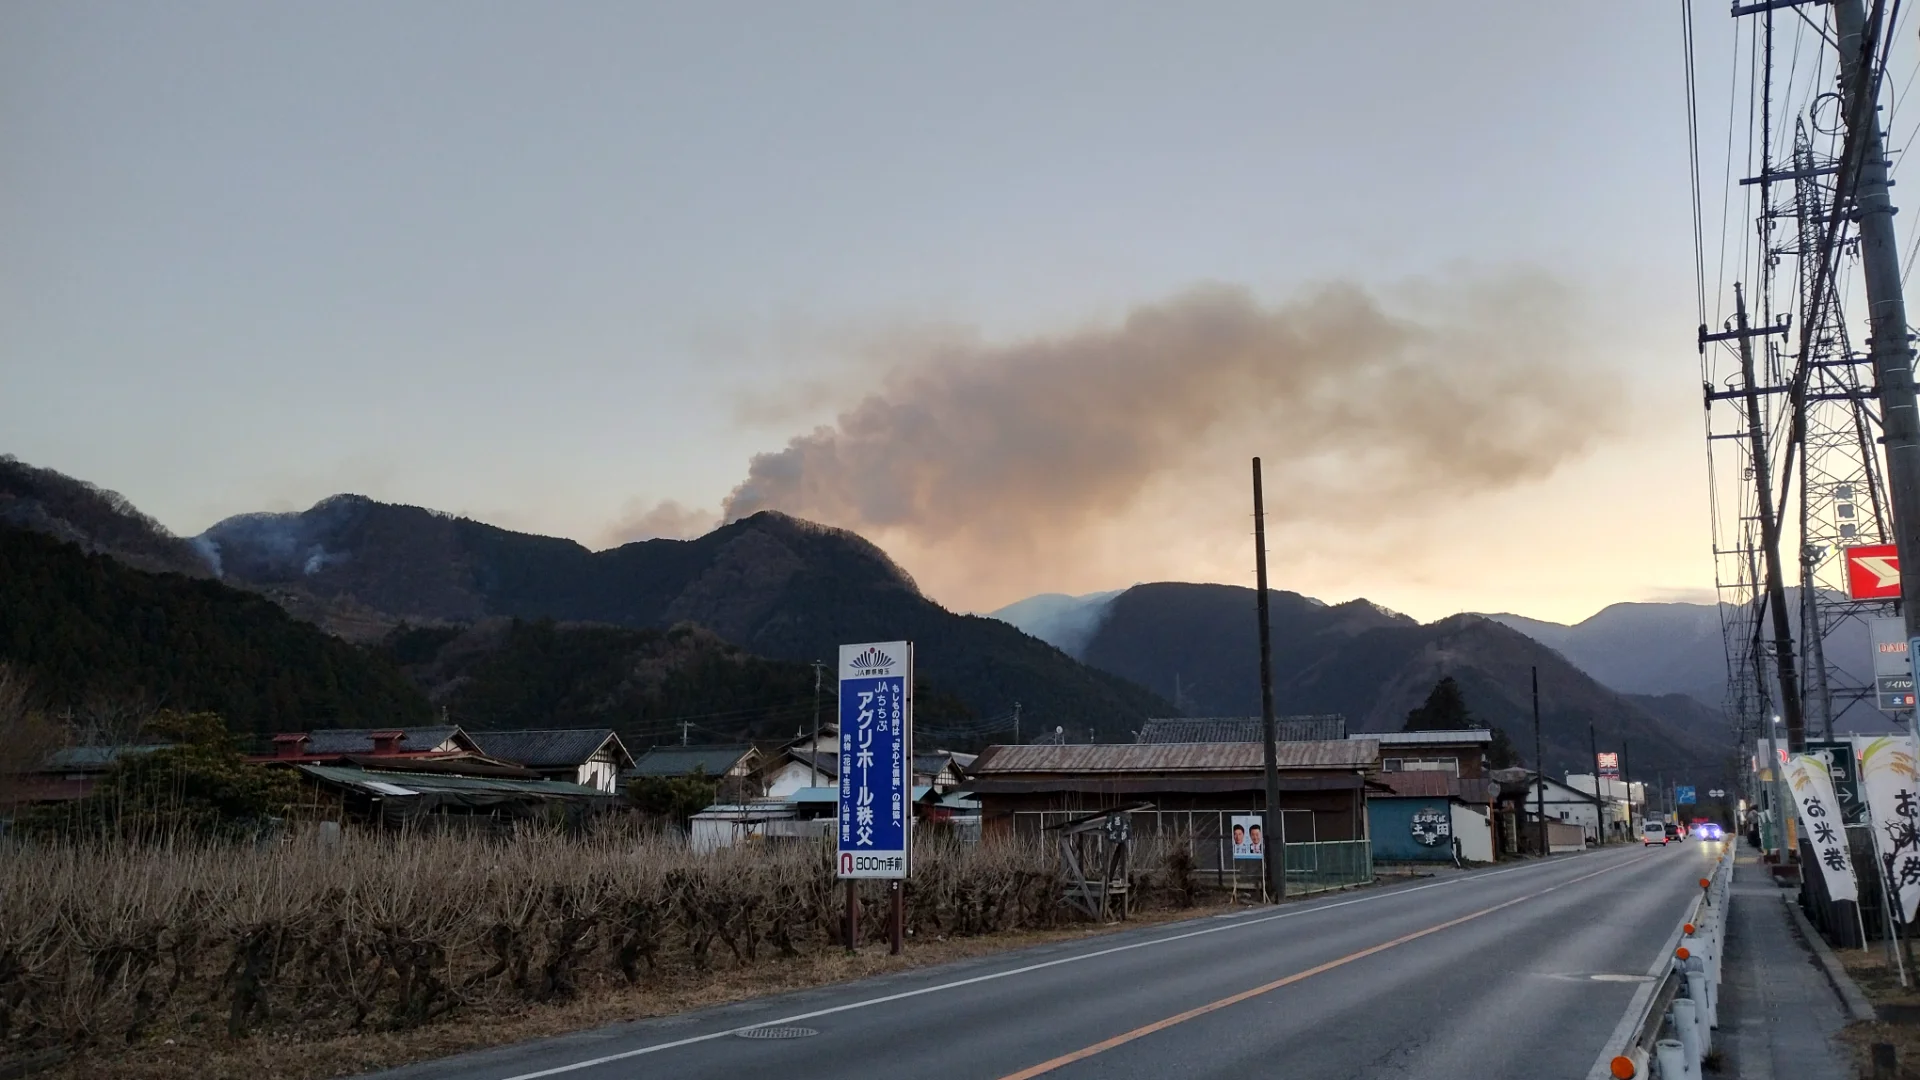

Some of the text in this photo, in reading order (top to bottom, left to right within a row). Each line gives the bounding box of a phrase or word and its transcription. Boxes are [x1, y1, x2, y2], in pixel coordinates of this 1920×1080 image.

[856, 691, 874, 846] アグリホール秩父
[856, 856, 903, 871] 800m手前
[1803, 796, 1847, 872] お米券
